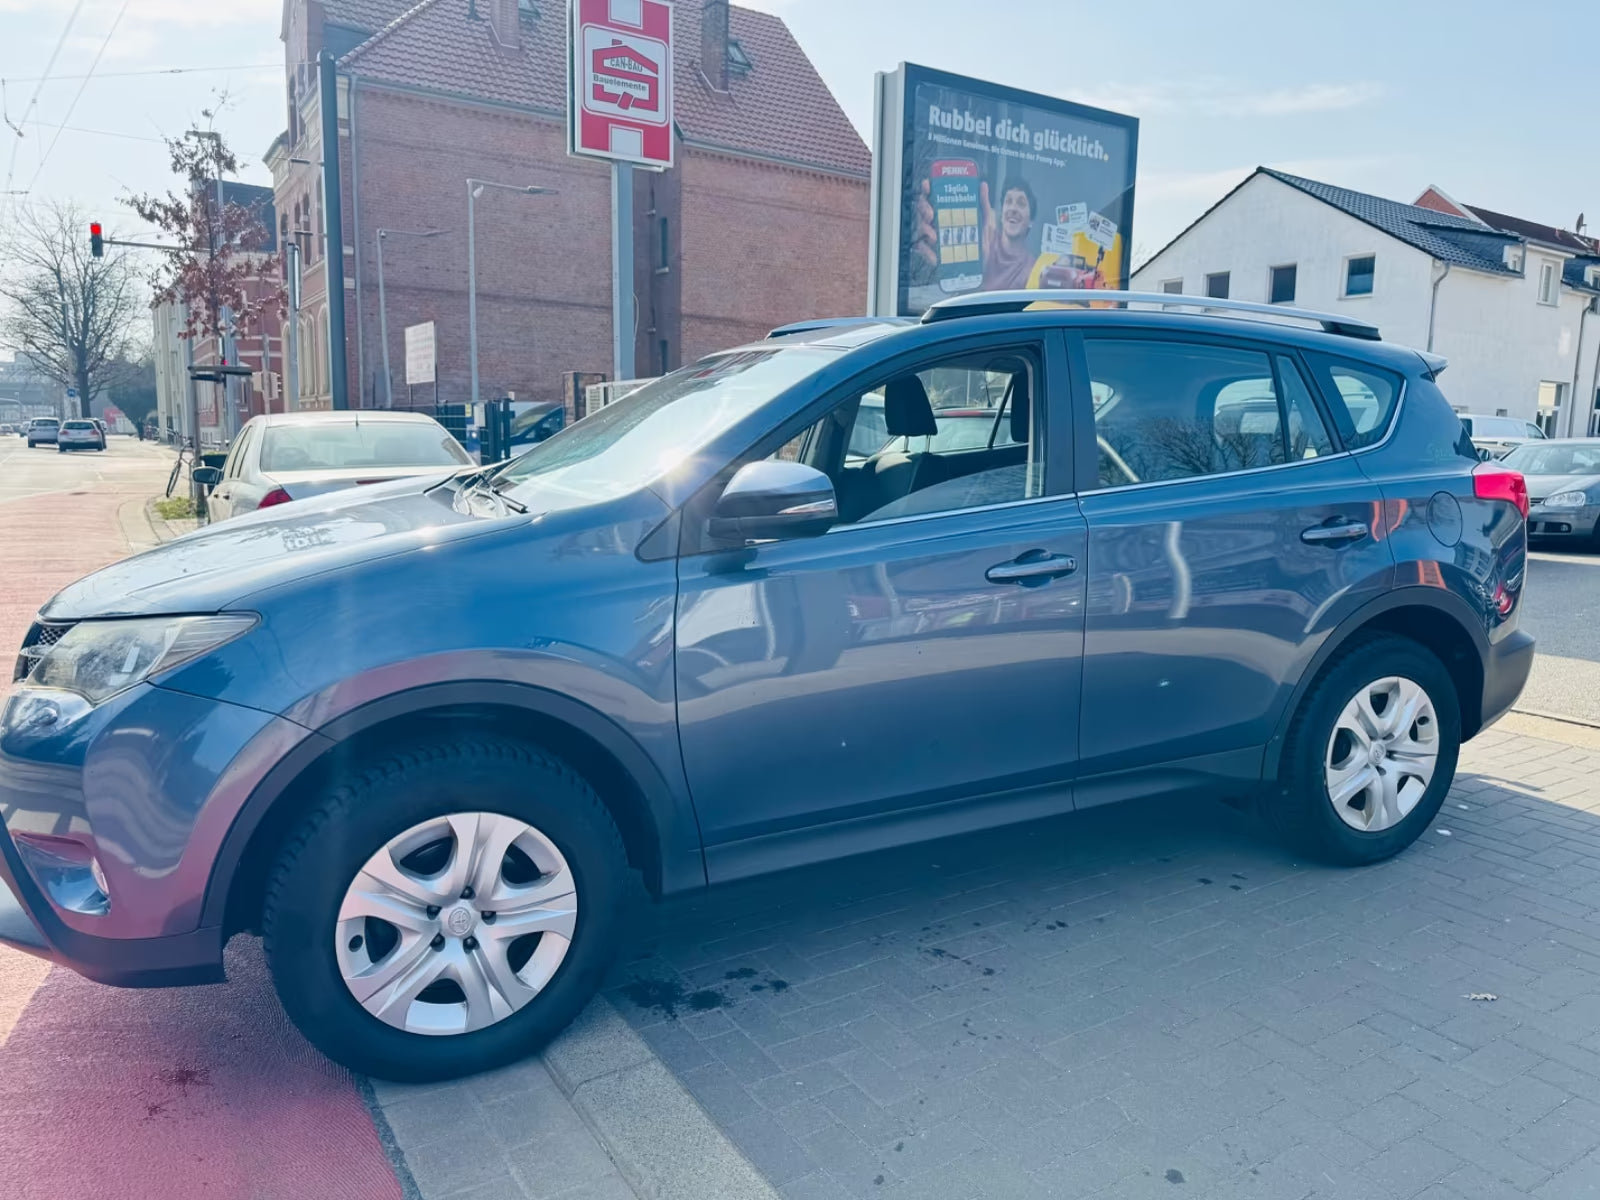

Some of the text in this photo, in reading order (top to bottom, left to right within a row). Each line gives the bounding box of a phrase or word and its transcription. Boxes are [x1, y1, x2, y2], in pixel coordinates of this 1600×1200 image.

[610, 57, 643, 72] CAN-BAU
[593, 73, 647, 92] Bauelemente
[929, 105, 1109, 162] Rubbel dich glücklich.
[943, 183, 969, 196] Täglich
